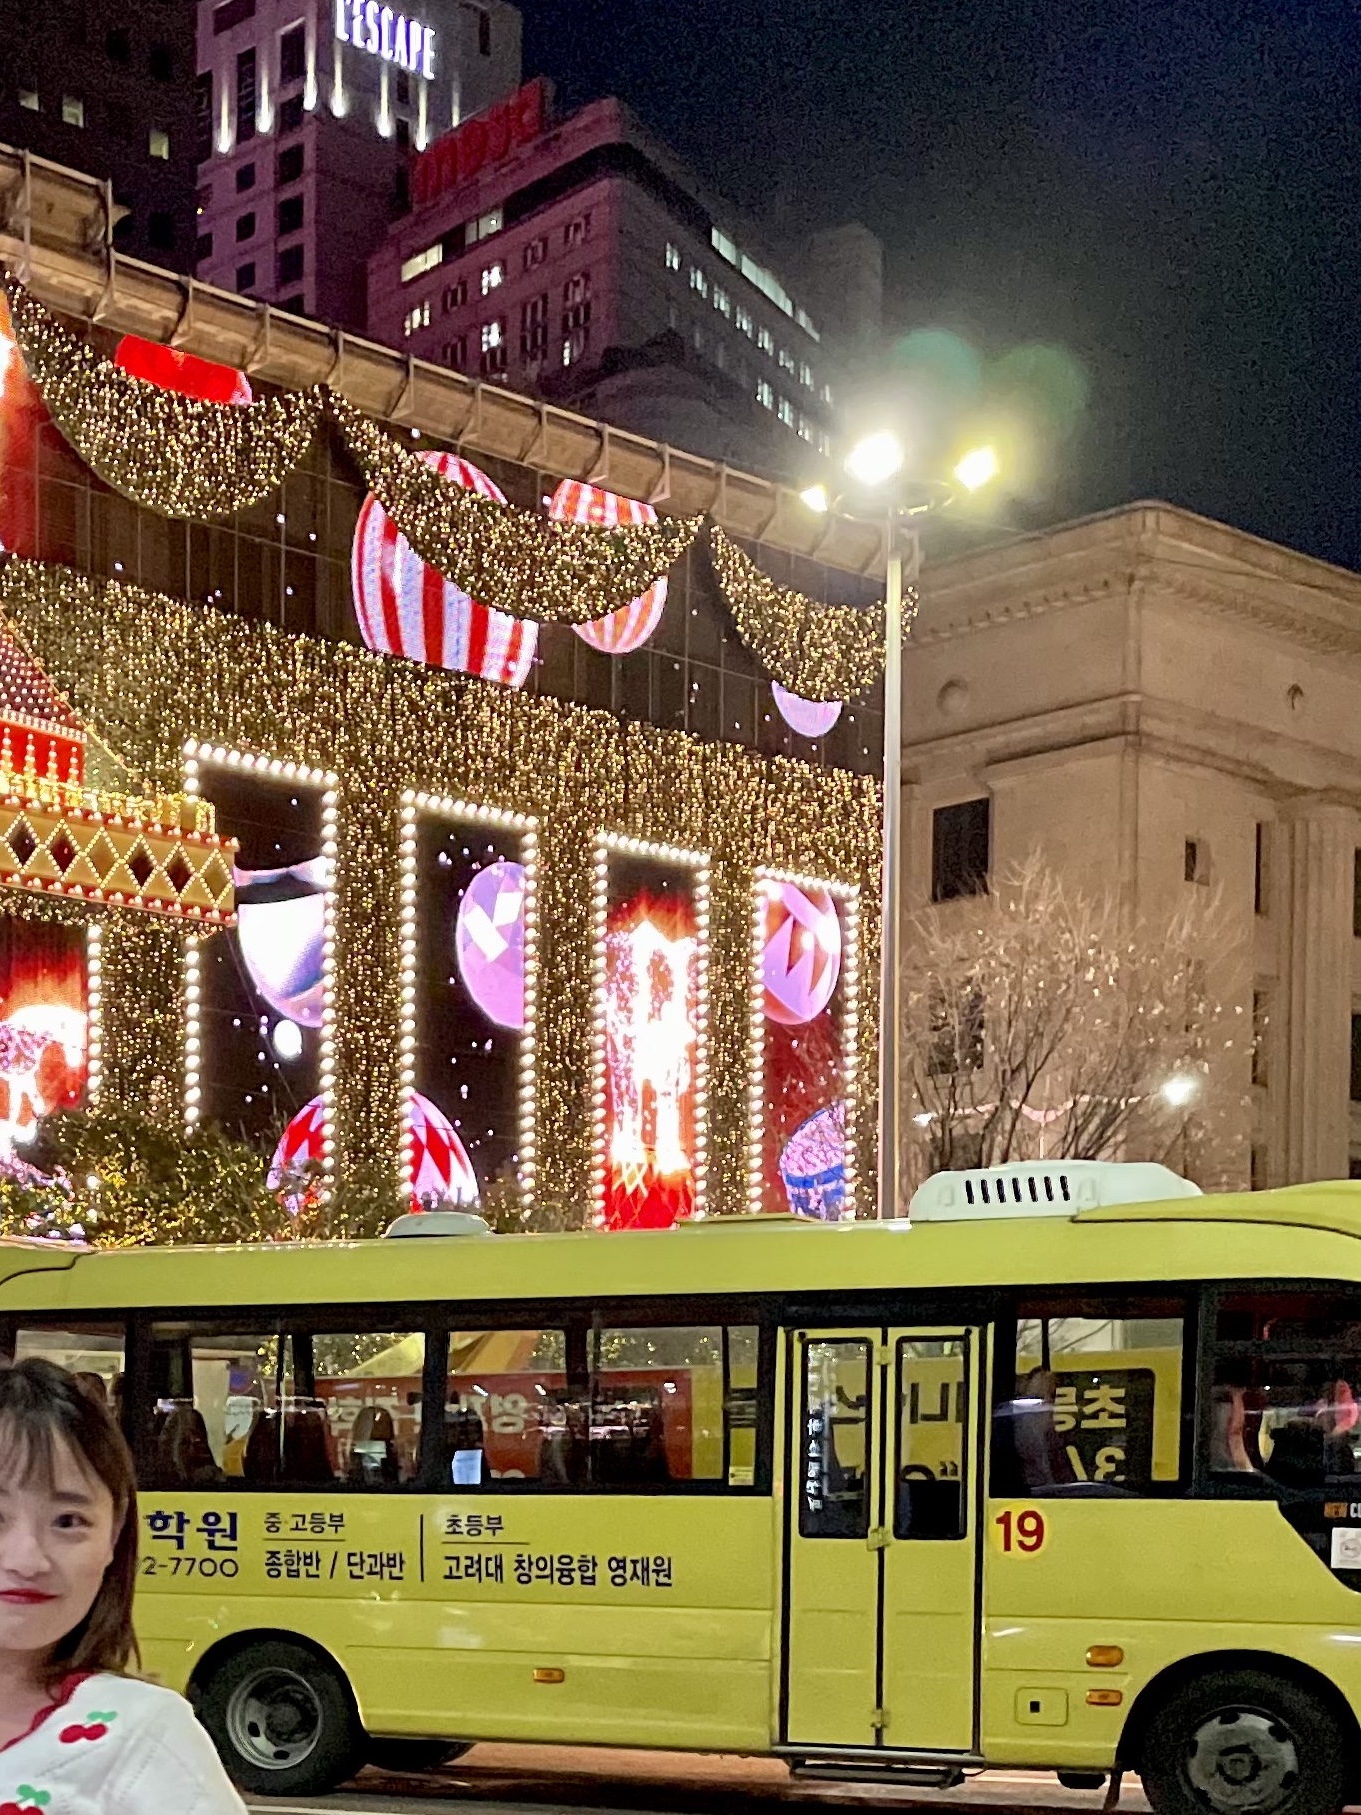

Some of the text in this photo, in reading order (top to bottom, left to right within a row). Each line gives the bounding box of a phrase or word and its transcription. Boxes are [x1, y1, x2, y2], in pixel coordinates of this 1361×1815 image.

[143, 1510, 239, 1551] 학원
[444, 1514, 504, 1537] 초등부
[995, 1511, 1045, 1552] 19
[142, 1556, 238, 1577] 2-7700
[264, 1550, 321, 1579] 종합반
[347, 1550, 405, 1580] 단과반
[443, 1554, 673, 1587] 고려대 창의융합 영재원
